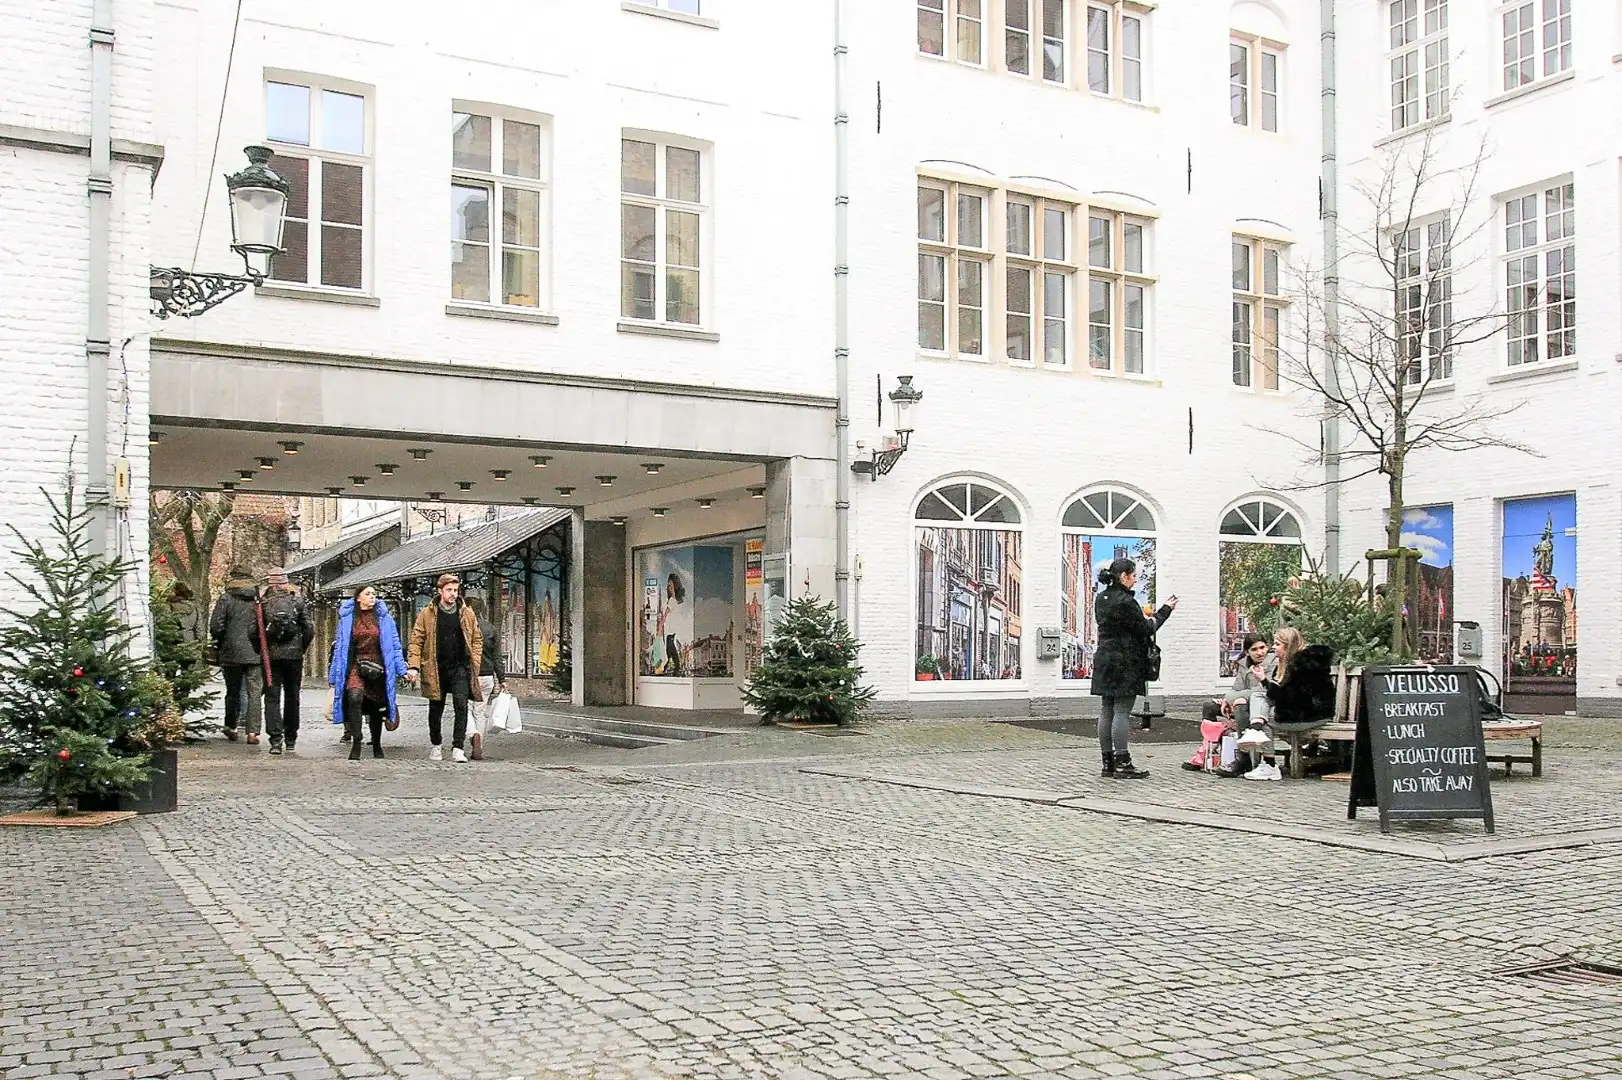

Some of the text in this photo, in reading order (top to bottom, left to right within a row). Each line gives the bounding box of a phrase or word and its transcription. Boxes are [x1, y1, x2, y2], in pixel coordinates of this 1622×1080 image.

[1462, 641, 1473, 651] 25
[1384, 674, 1460, 693] VELUSSO
[1384, 702, 1447, 718] BREAKFAST
[1387, 723, 1425, 739] LUNCH
[1388, 746, 1478, 766] SPECIALTY COFFEE
[1392, 775, 1473, 793] ALSO TAKE AWAY
